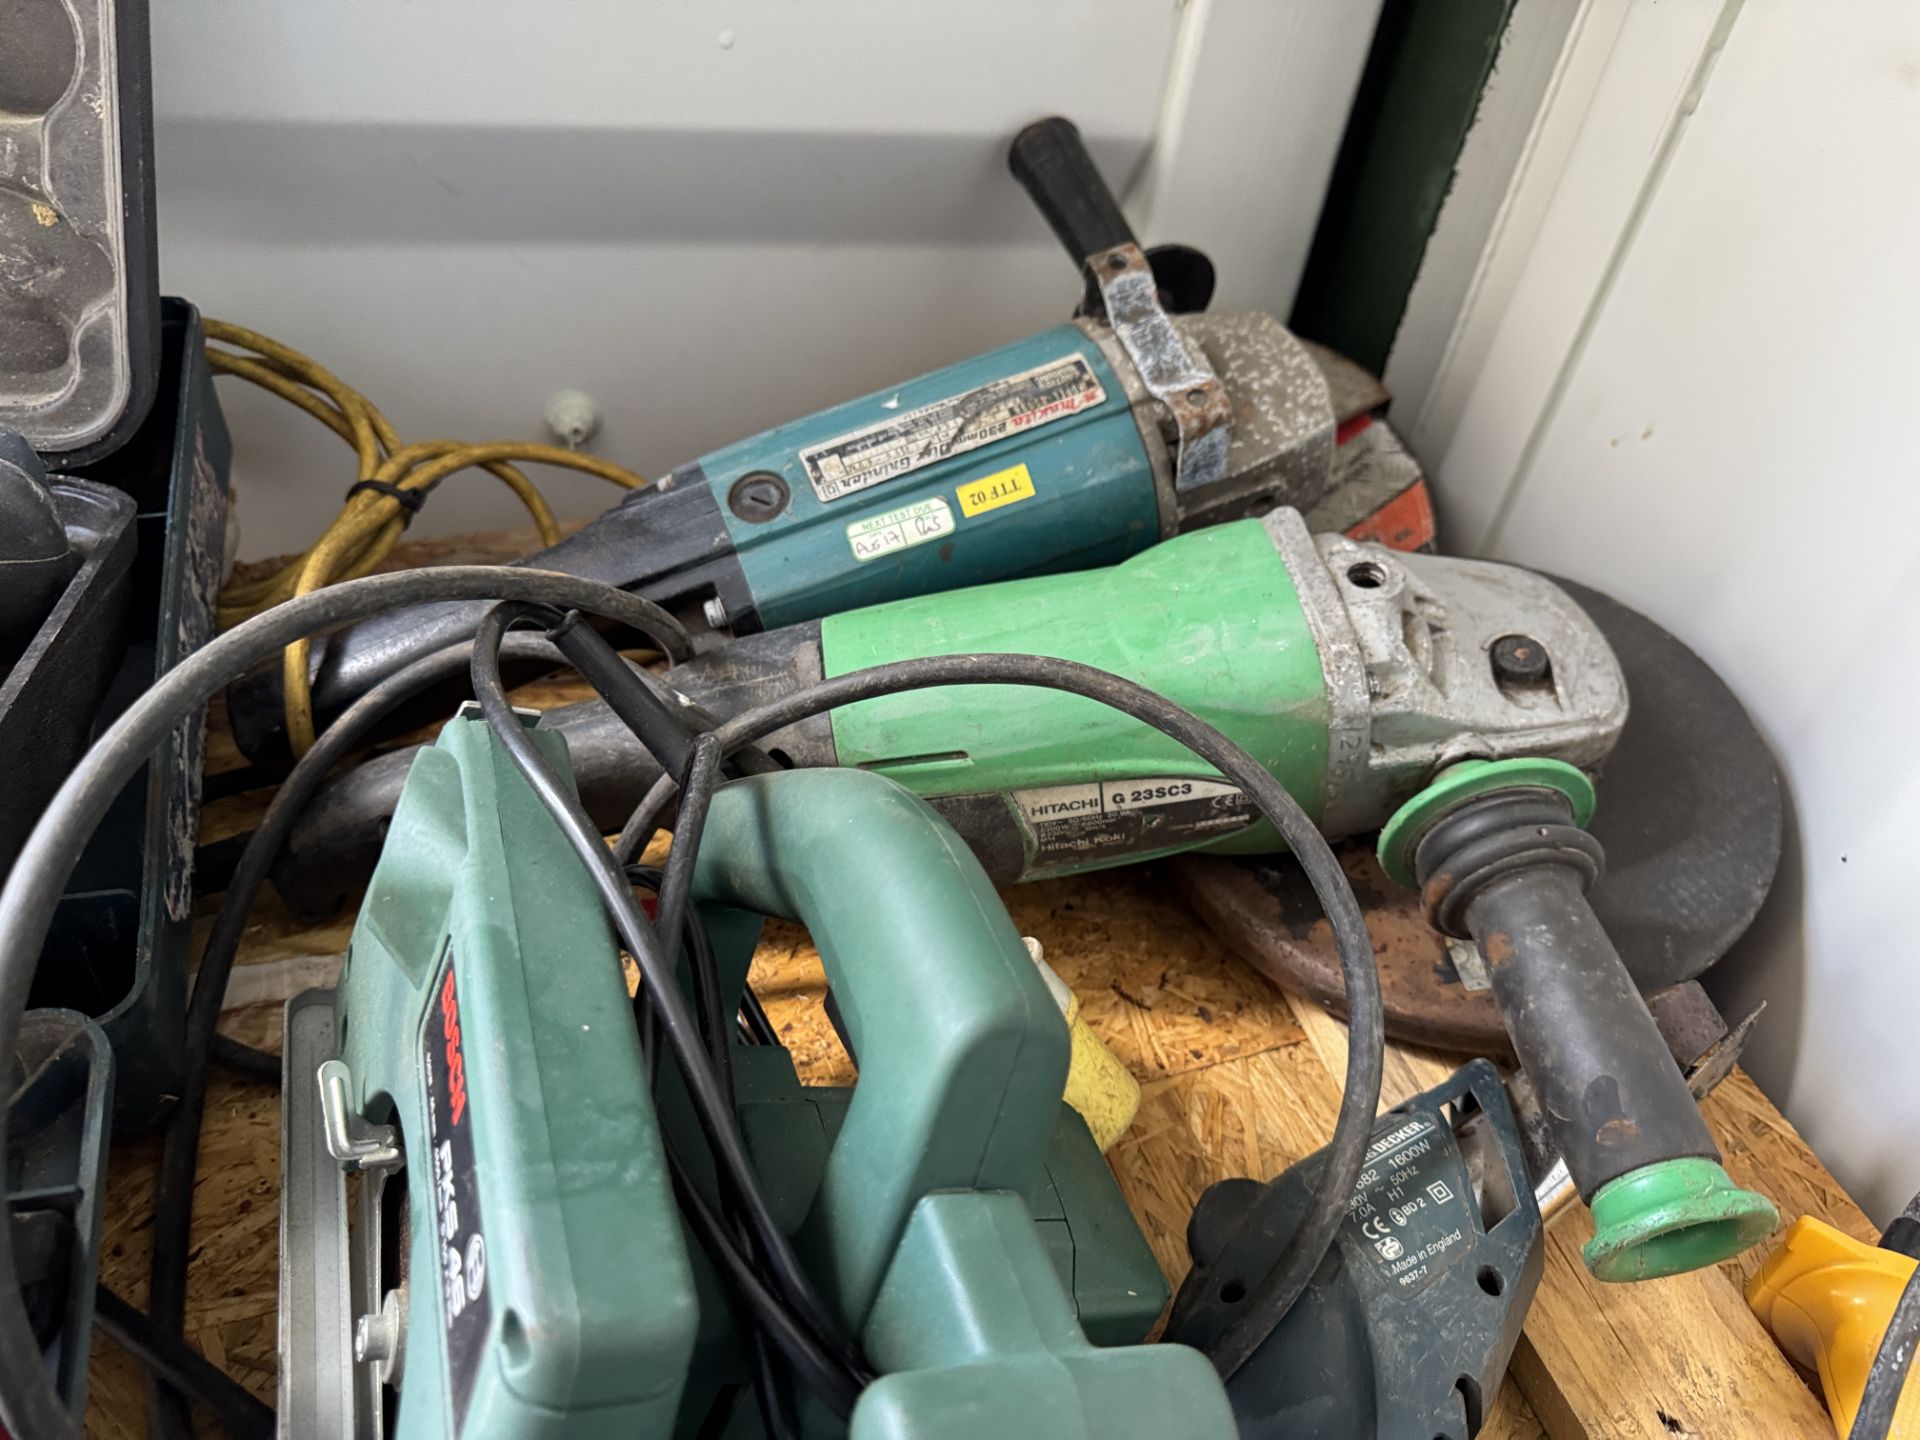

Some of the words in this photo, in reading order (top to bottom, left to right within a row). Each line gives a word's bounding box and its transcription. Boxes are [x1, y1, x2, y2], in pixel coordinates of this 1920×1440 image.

[969, 490, 987, 507] 02
[989, 479, 1022, 500] TTF
[861, 517, 886, 531] NEXT
[888, 510, 911, 524] TEST
[912, 503, 933, 515] DUE
[1031, 798, 1098, 816] HITACHI
[1111, 793, 1126, 805] G
[1131, 783, 1193, 803] 23SC3
[442, 970, 466, 1126] BOSCH
[1388, 1138, 1431, 1169] 1600W
[1389, 1165, 1420, 1186] 50Hz
[1391, 1254, 1418, 1275] Made
[1416, 1249, 1428, 1261] in
[1425, 1228, 1462, 1253] England
